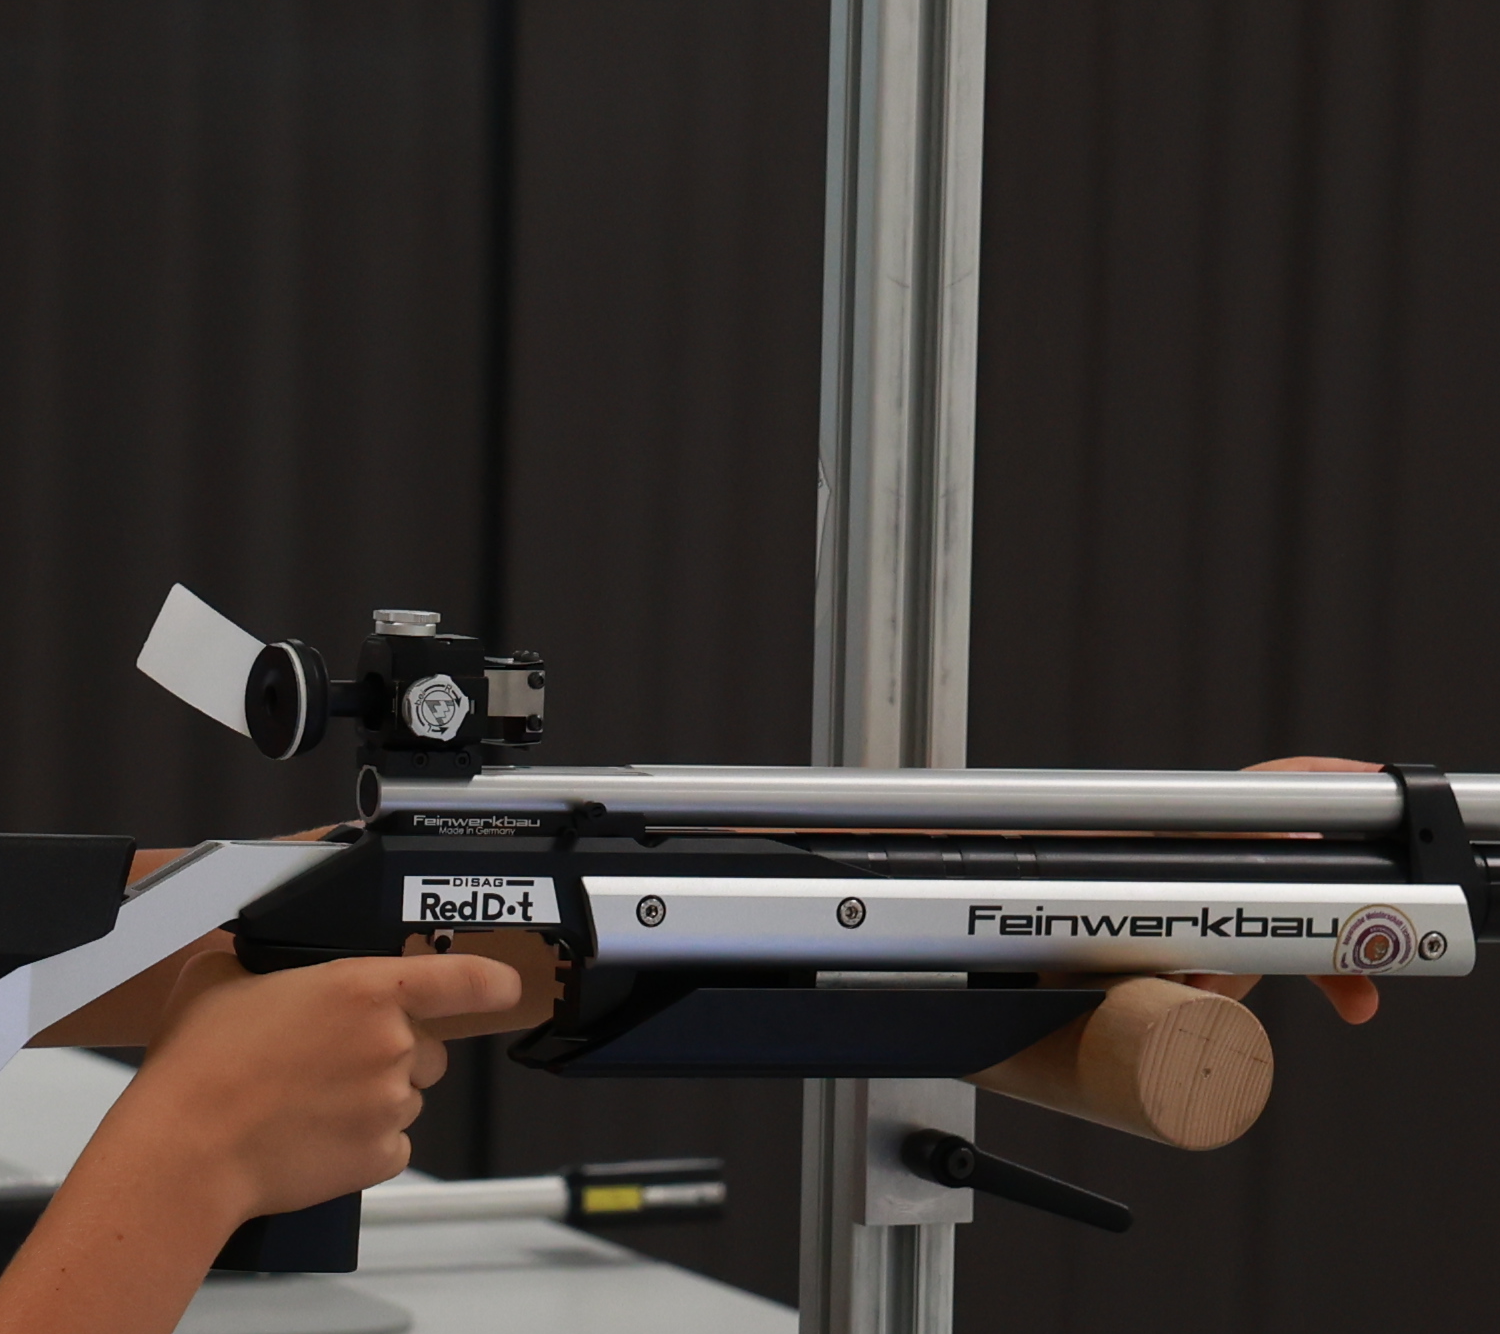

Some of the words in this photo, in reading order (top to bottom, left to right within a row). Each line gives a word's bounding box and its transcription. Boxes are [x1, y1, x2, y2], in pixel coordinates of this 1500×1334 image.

[413, 815, 541, 828] Feinwerkbau
[438, 826, 465, 836] Made
[466, 826, 475, 835] in
[475, 826, 517, 836] Germany
[452, 877, 505, 888] DISAG
[967, 904, 1340, 939] Feinwerkbau
